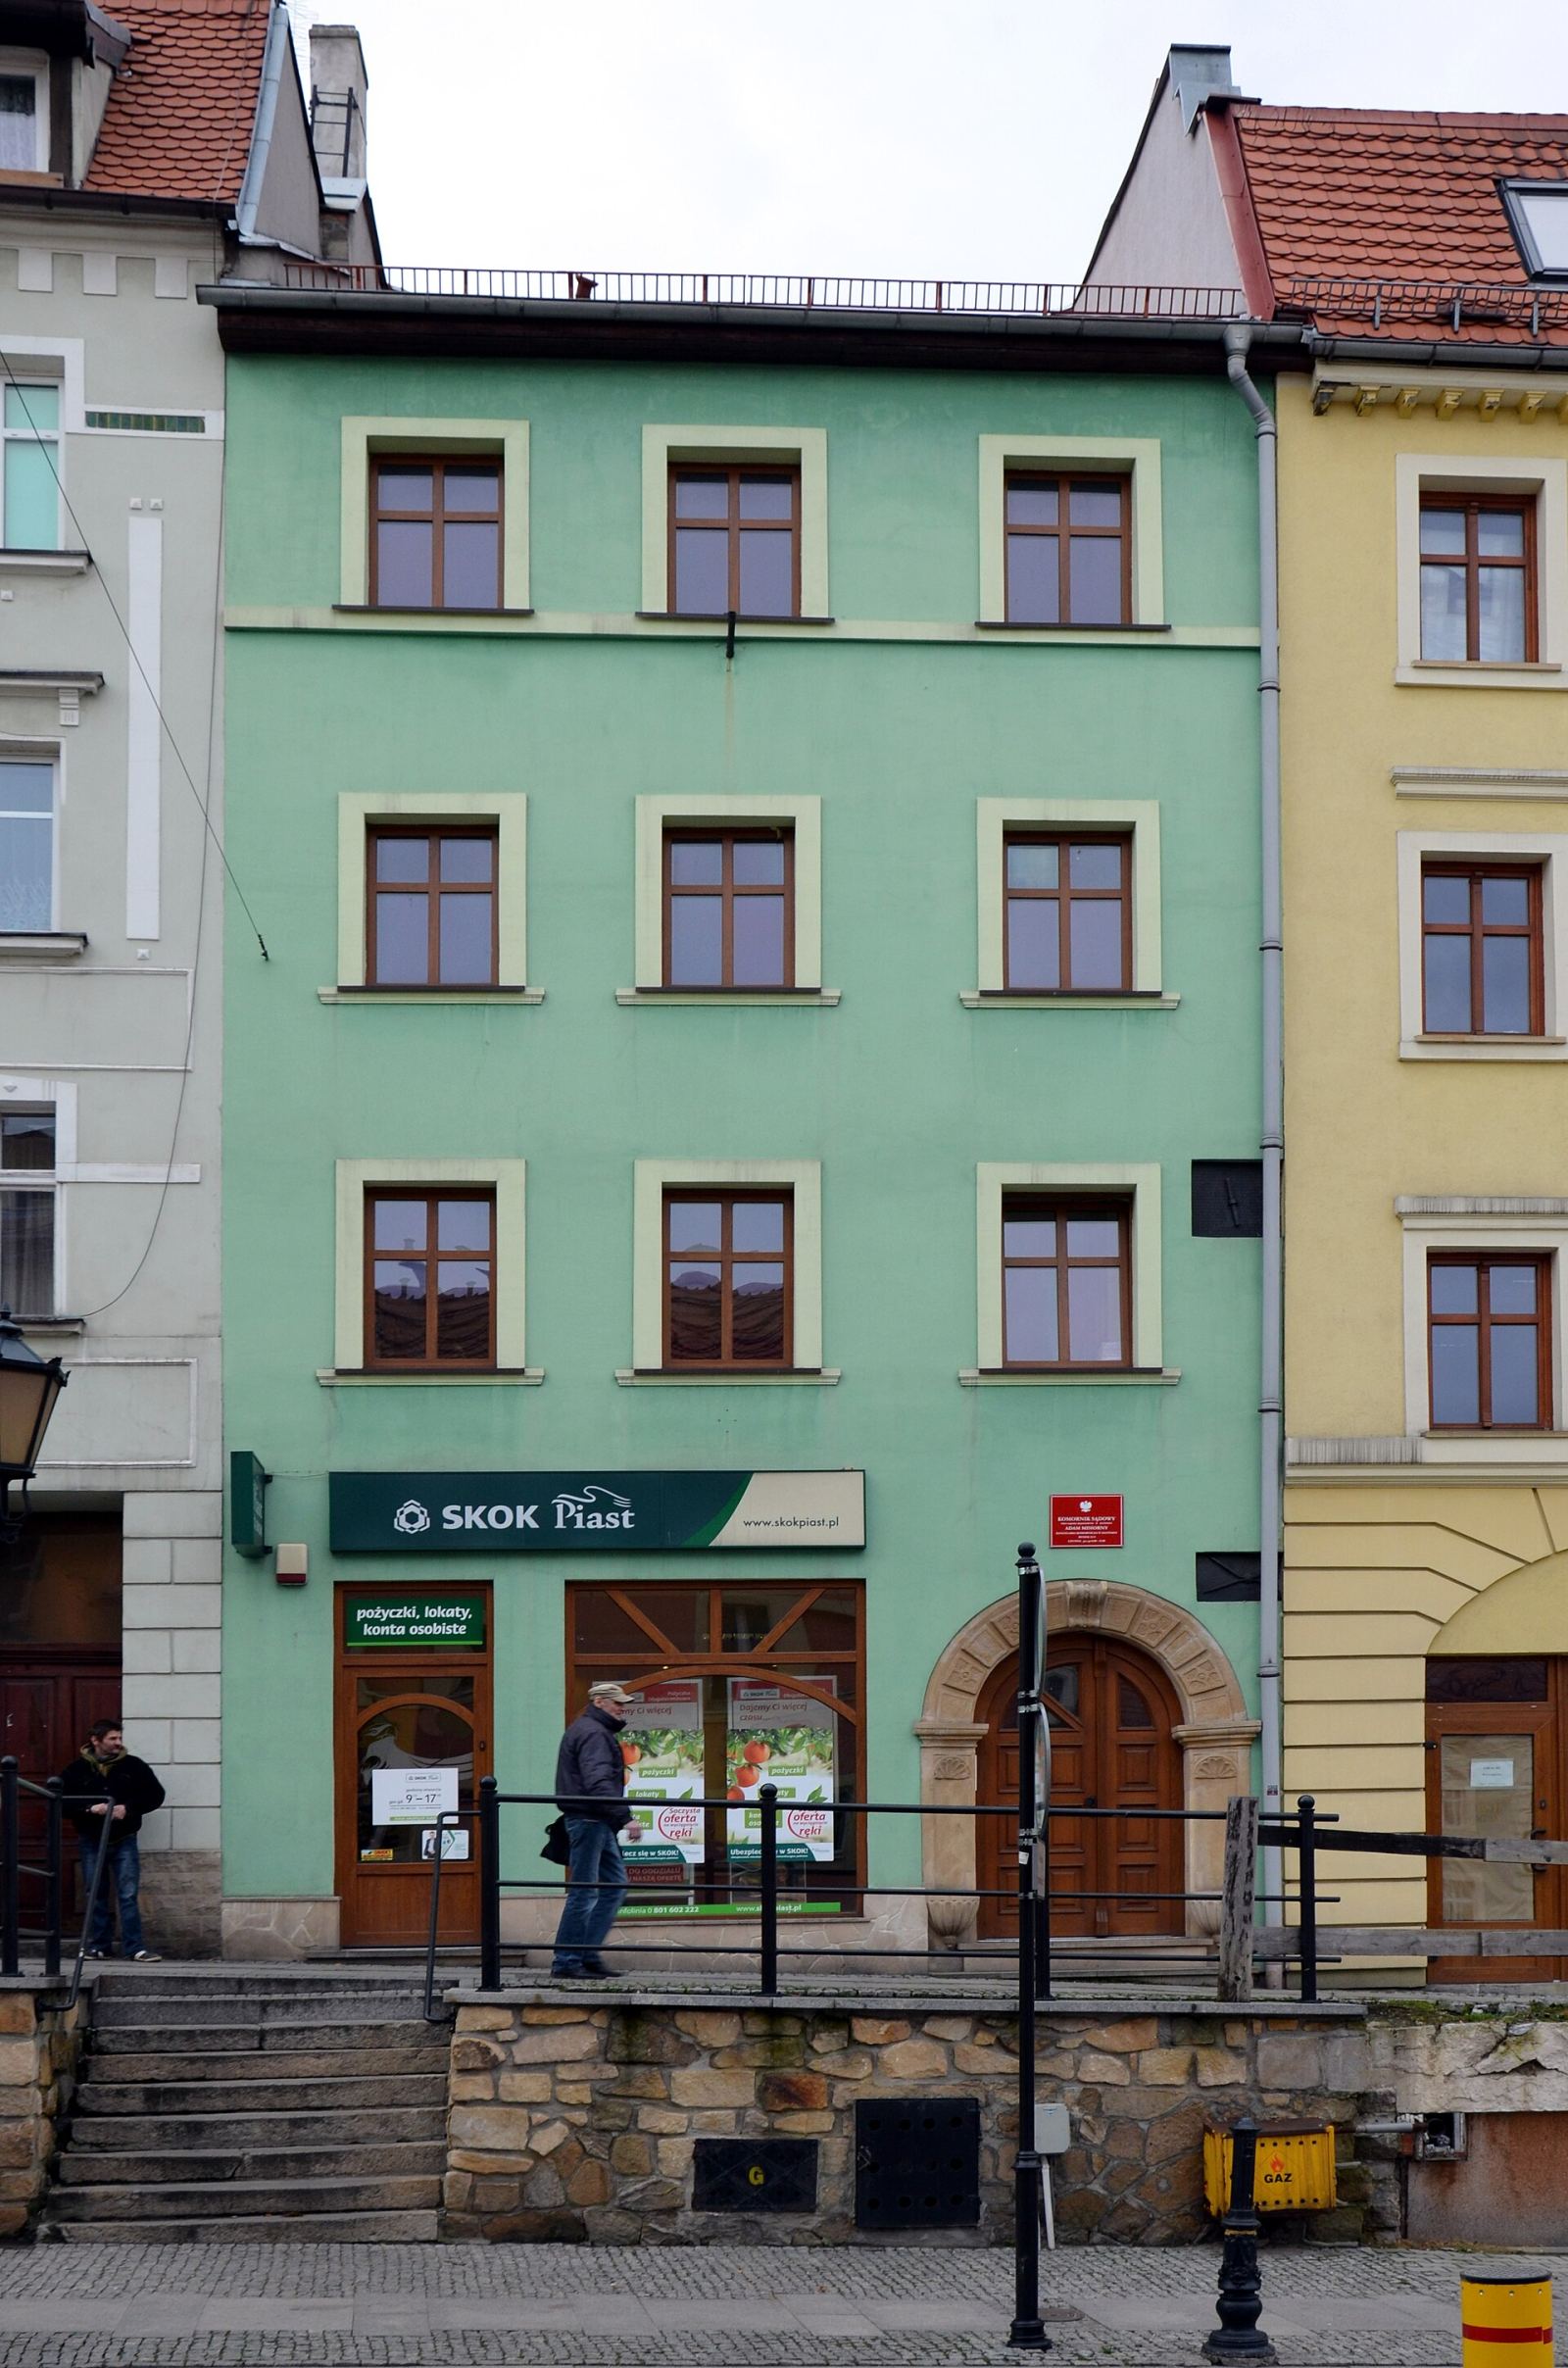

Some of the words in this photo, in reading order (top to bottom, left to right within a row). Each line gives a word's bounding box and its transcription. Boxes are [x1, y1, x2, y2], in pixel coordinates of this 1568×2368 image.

[442, 1505, 539, 1529] SKOK
[552, 1499, 635, 1529] Piast
[744, 1516, 839, 1529] www.skokpiast.pl
[356, 1606, 420, 1621] pożyczki,
[424, 1606, 472, 1620] lokaty,
[363, 1623, 406, 1636] konta
[409, 1622, 466, 1635] osobiste
[642, 1768, 674, 1777] pożyczki
[664, 1813, 697, 1823] oferta
[794, 1812, 826, 1821] oferta
[669, 1827, 693, 1840] ręki
[800, 1825, 822, 1838] ręki
[748, 2166, 764, 2186] G
[1264, 2173, 1293, 2184] GAZ
